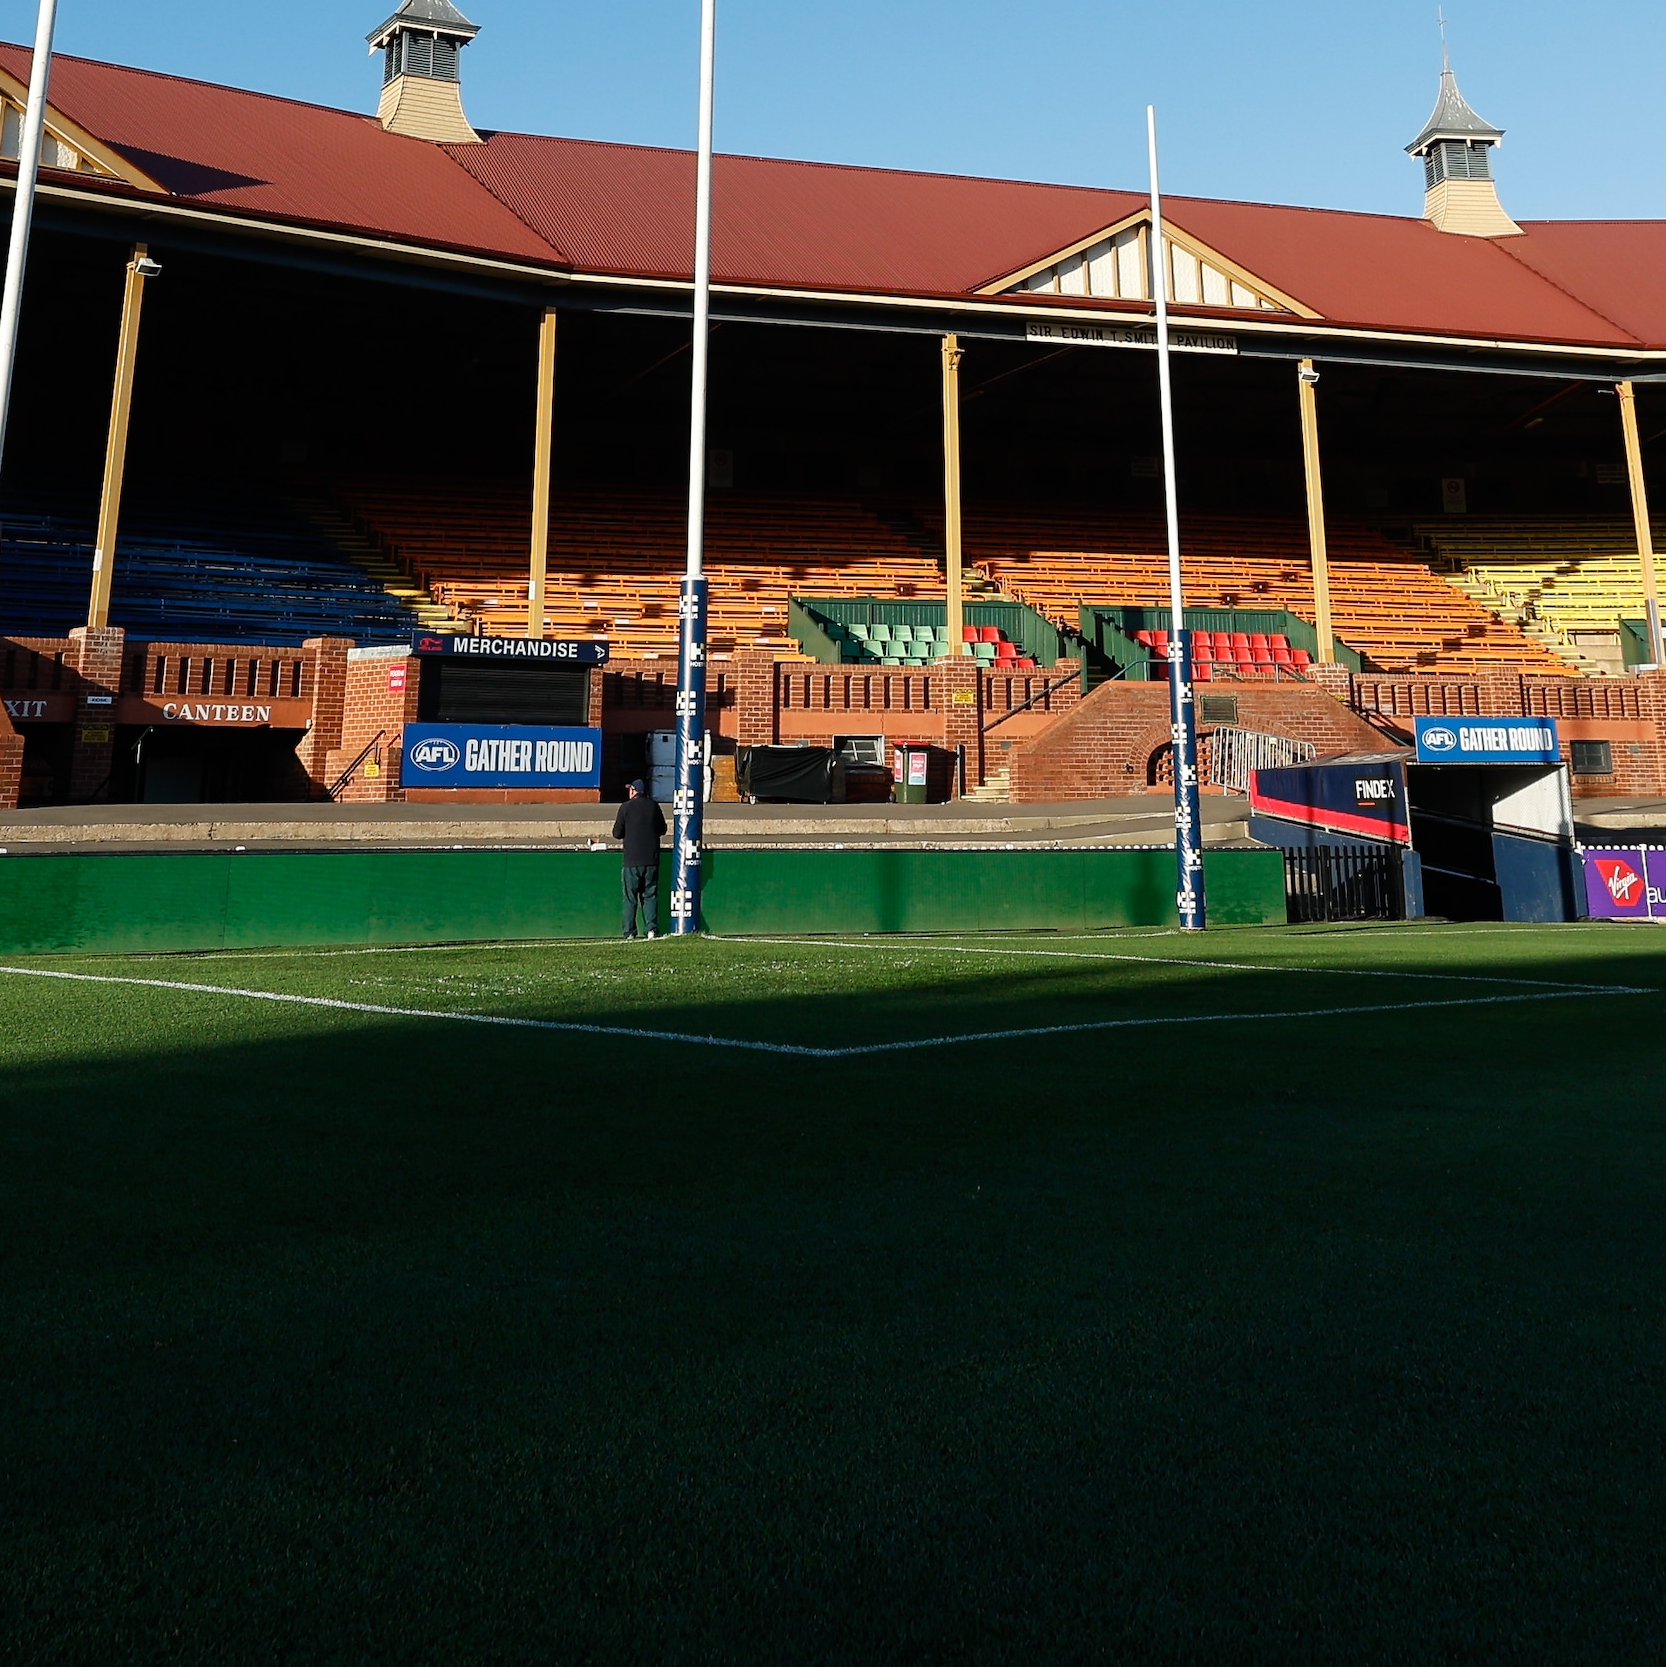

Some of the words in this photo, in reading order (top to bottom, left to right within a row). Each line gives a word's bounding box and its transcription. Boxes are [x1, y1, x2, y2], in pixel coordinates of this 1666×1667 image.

[1030, 325, 1052, 337] SIR
[1061, 327, 1104, 342] EDWIN
[1177, 335, 1235, 350] PAVILION
[453, 637, 579, 658] MERCHANDISE
[3, 700, 48, 718] XIT
[163, 703, 272, 722] CANTEEN
[1426, 732, 1454, 746] AFL
[1459, 727, 1509, 752] GATHER
[1510, 727, 1553, 752] ROUND
[416, 746, 456, 763] AFL
[464, 739, 533, 772] GATHER
[535, 740, 594, 773] ROUND
[1354, 779, 1396, 799] FINDEX
[1608, 866, 1638, 900] Virgin
